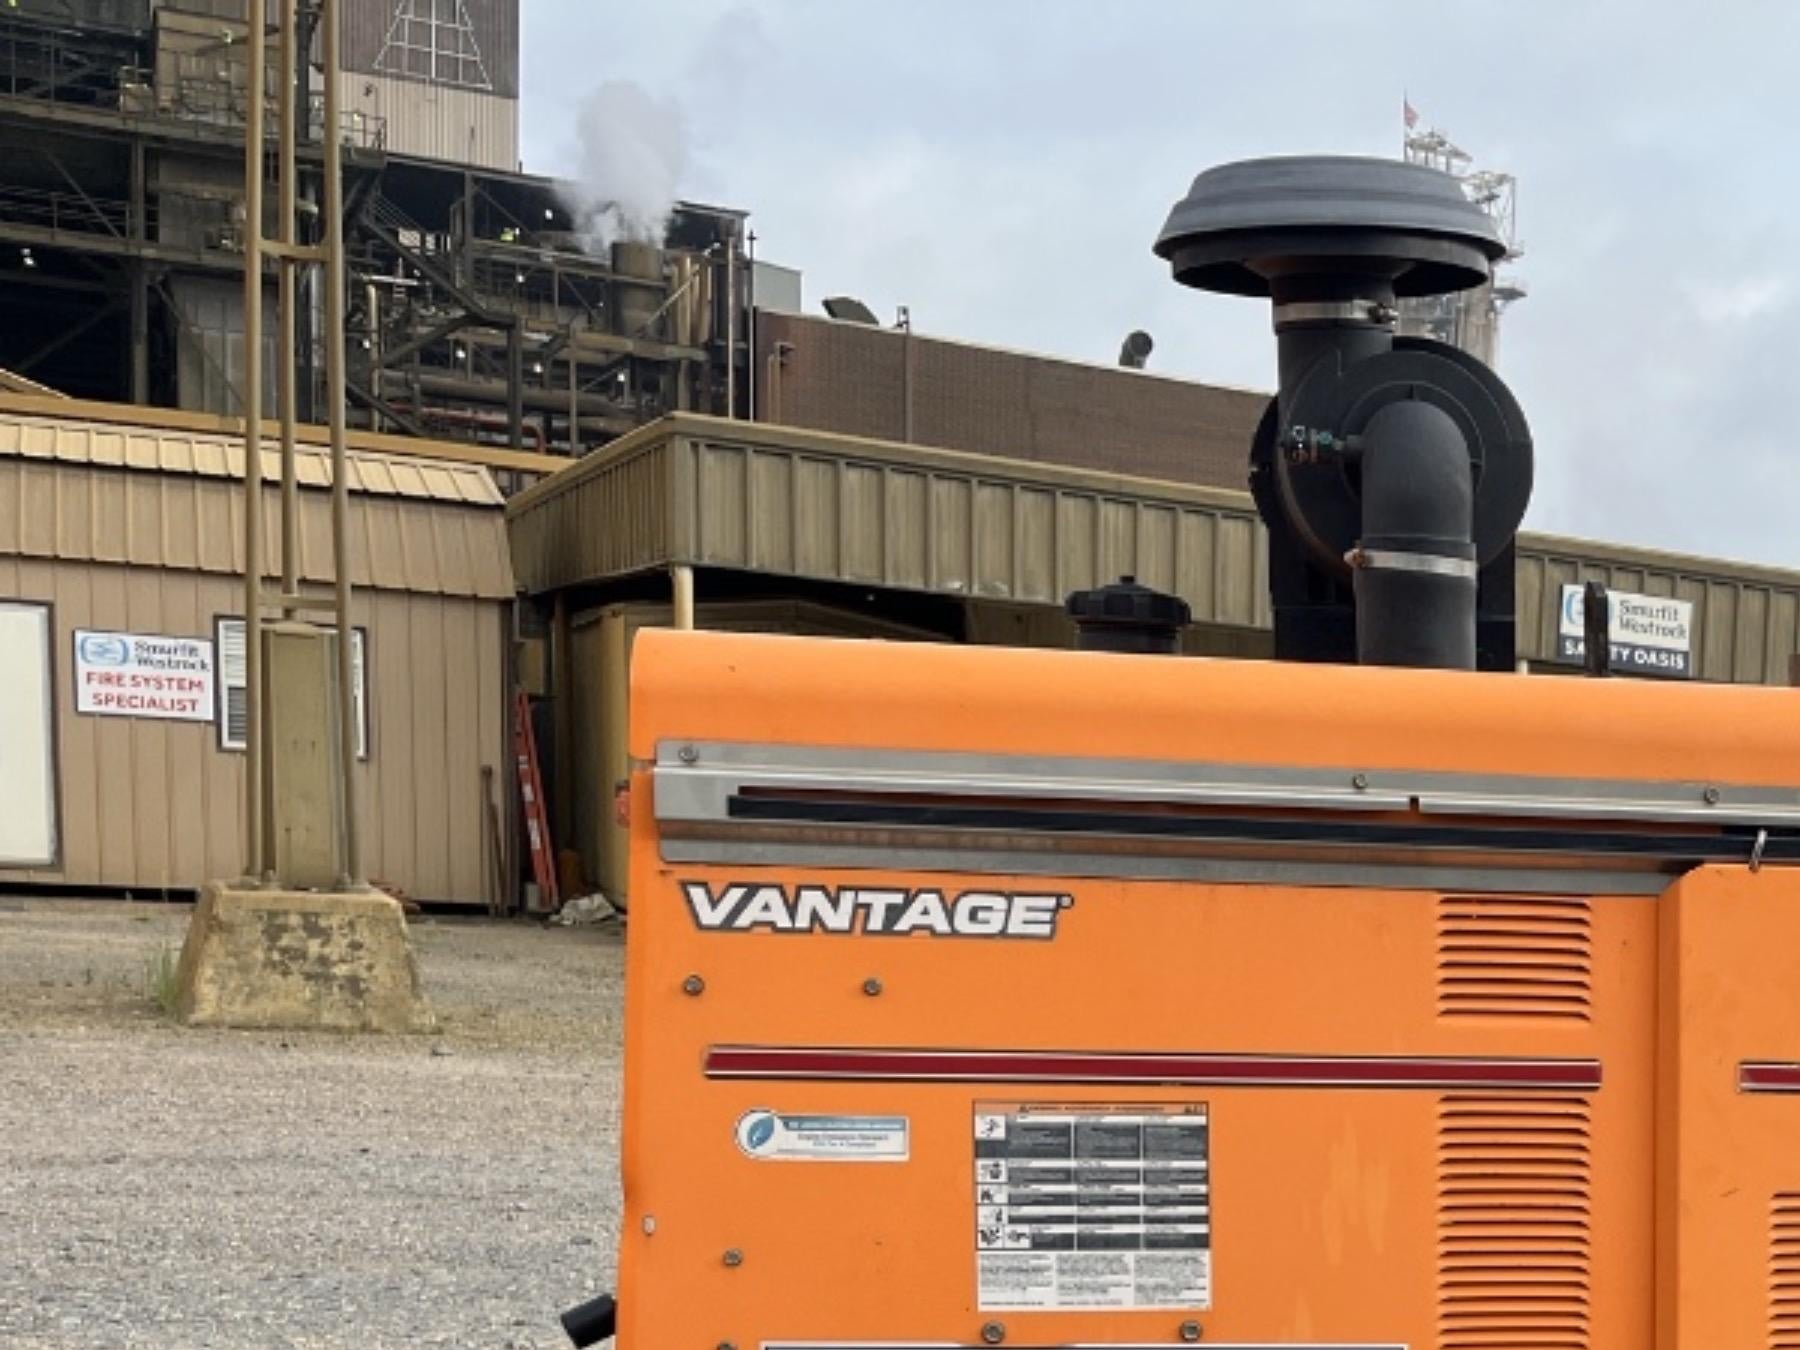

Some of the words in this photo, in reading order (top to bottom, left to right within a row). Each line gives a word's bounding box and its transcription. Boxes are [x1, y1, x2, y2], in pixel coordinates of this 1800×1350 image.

[1634, 650, 1684, 670] OASIS
[86, 671, 127, 688] FIRE
[130, 674, 205, 692] SYSTEM
[92, 692, 200, 712] SPECIALIST
[682, 882, 1062, 938] VANTAGE
